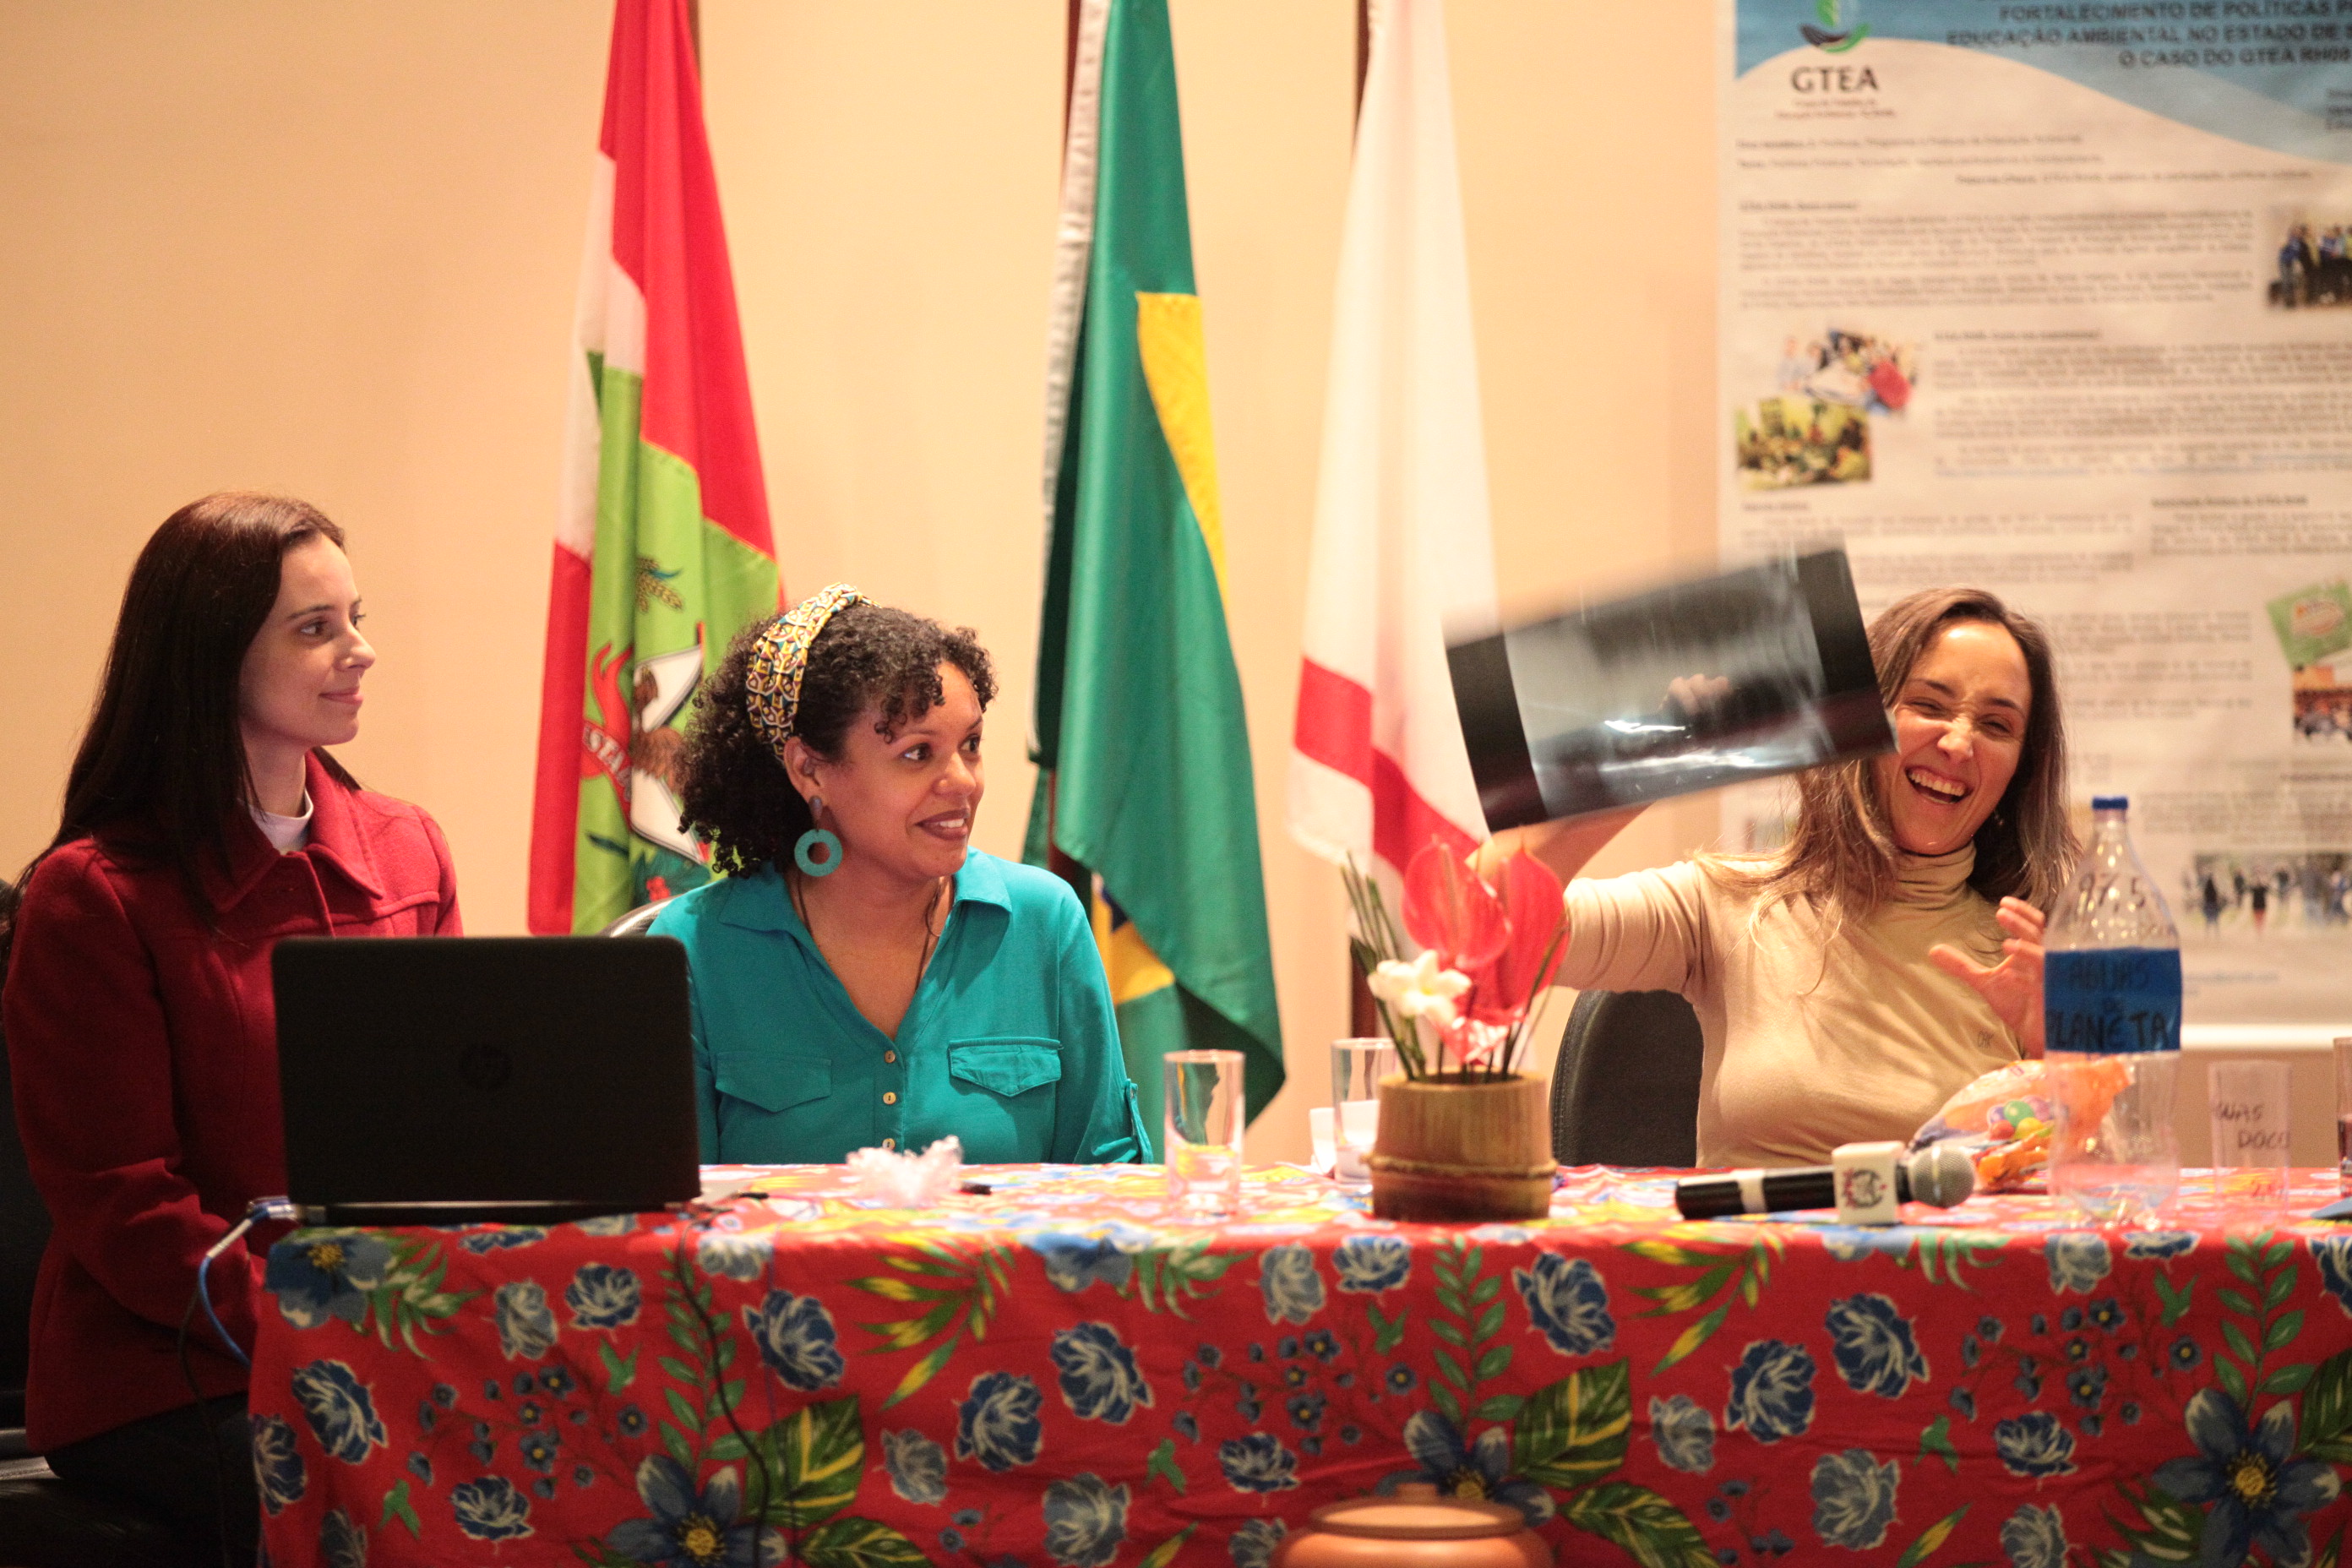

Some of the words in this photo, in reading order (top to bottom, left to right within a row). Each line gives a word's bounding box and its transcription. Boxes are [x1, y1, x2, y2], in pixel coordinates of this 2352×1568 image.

[1999, 3, 2185, 21] FORTALECIMENTO
[2190, 2, 2217, 19] DE
[1946, 27, 2062, 47] EDUCAÇÃO
[2067, 26, 2180, 43] AMBIENTAL
[2188, 25, 2219, 42] NO
[2223, 24, 2306, 41] ESTADO
[2311, 23, 2338, 41] DE
[2118, 48, 2137, 69] O
[2139, 47, 2197, 68] CASO
[2202, 46, 2234, 66] DO
[2240, 46, 2295, 64] GTEA
[1790, 65, 1879, 93] GTEA
